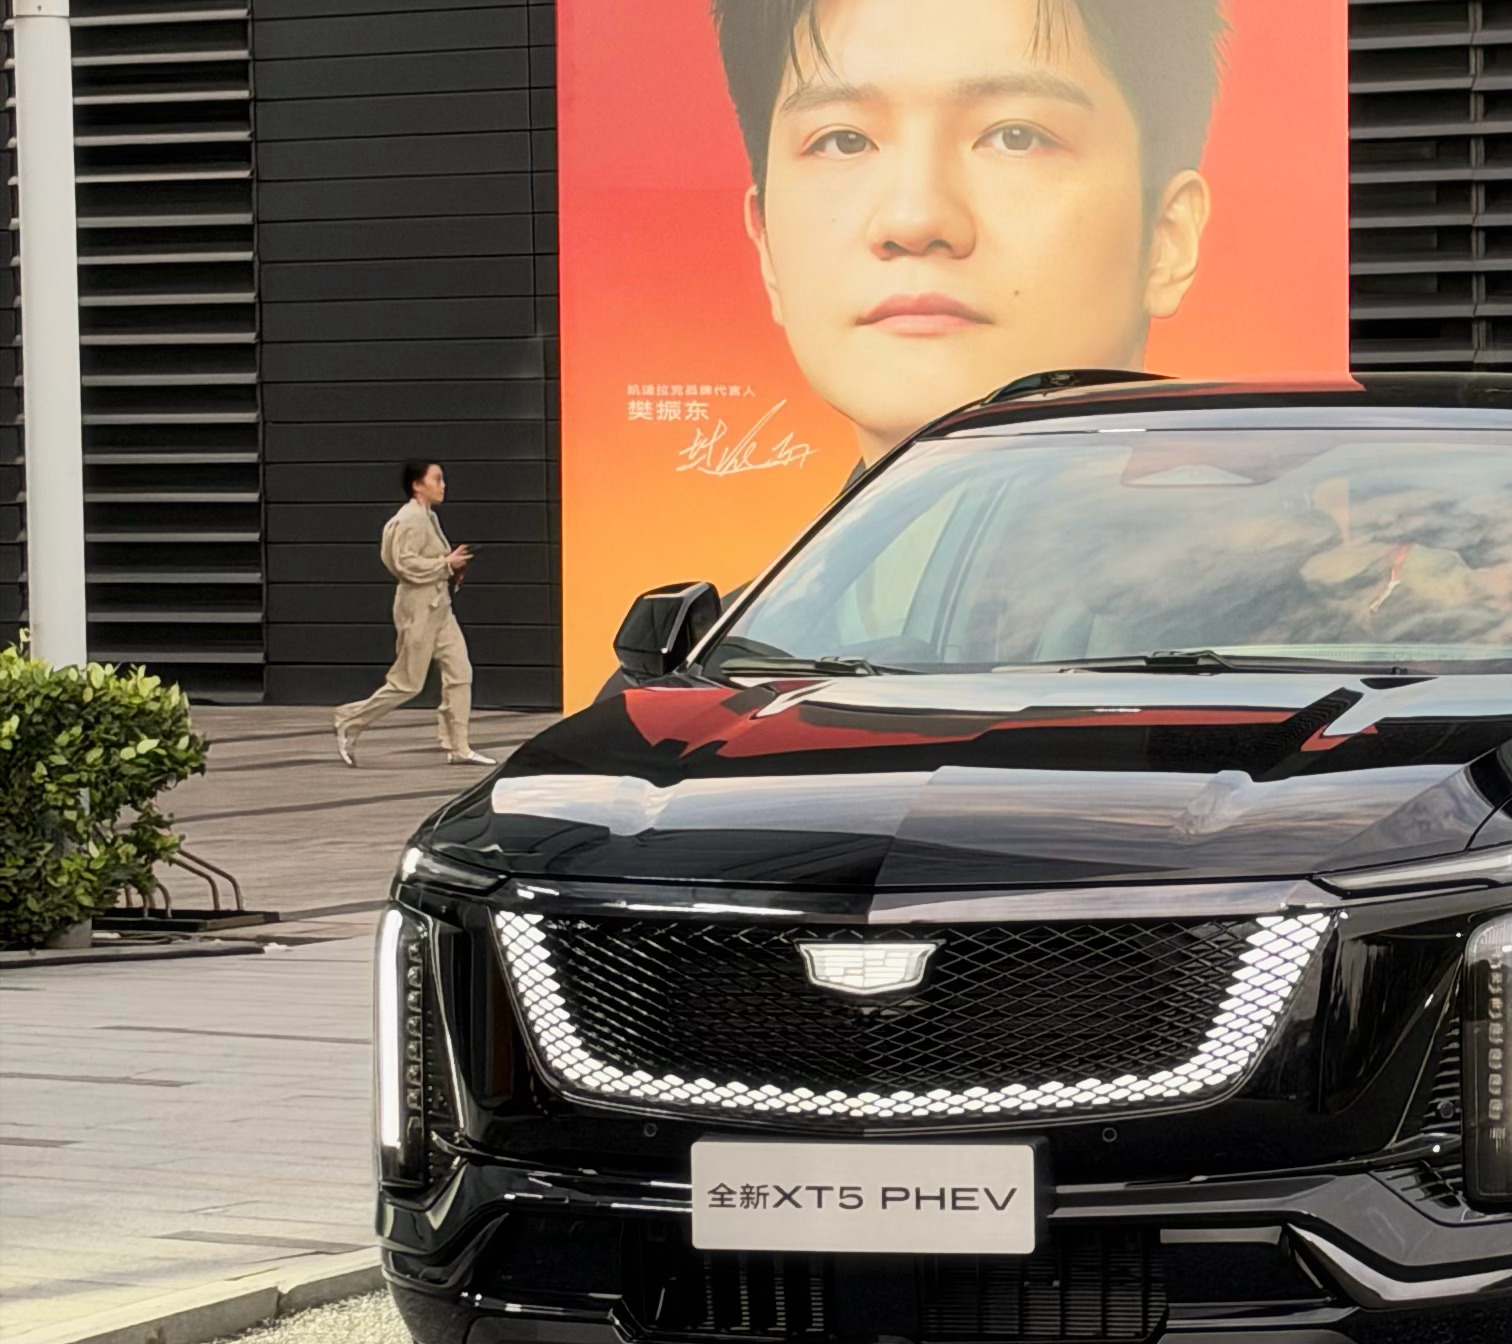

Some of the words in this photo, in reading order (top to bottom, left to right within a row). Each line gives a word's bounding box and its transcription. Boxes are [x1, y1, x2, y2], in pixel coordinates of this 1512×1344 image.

[627, 399, 710, 421] 樊振东
[707, 1182, 864, 1210] 全新XT5
[881, 1187, 1018, 1211] PHEV
